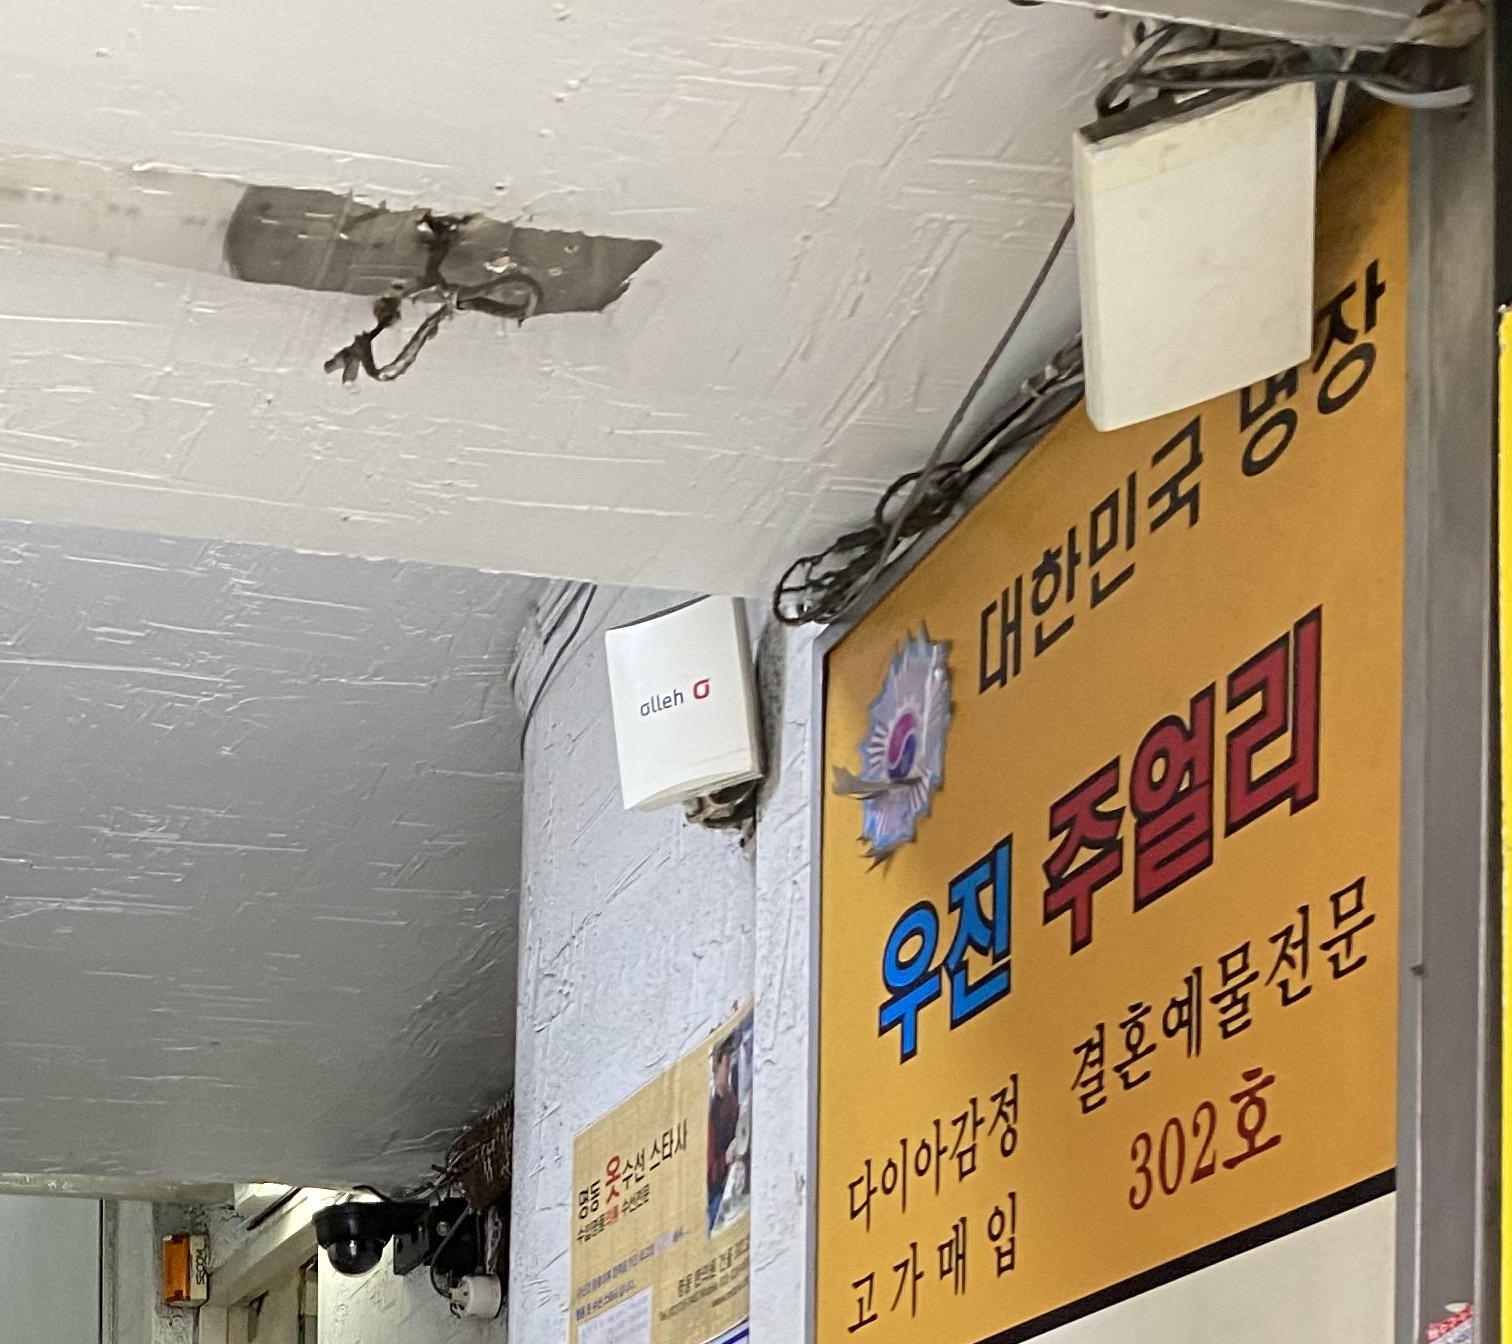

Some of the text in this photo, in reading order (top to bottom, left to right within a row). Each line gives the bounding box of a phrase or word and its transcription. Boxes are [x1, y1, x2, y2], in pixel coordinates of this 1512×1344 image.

[979, 415, 1204, 696] 대한민국
[640, 689, 684, 717] olleh
[878, 604, 1323, 1065] 우진 주얼리
[1070, 876, 1377, 1115] 결혼예물전문
[847, 1073, 1021, 1234] 다이아감정
[1128, 1065, 1282, 1211] 302호
[846, 1192, 1019, 1334] 고가매입
